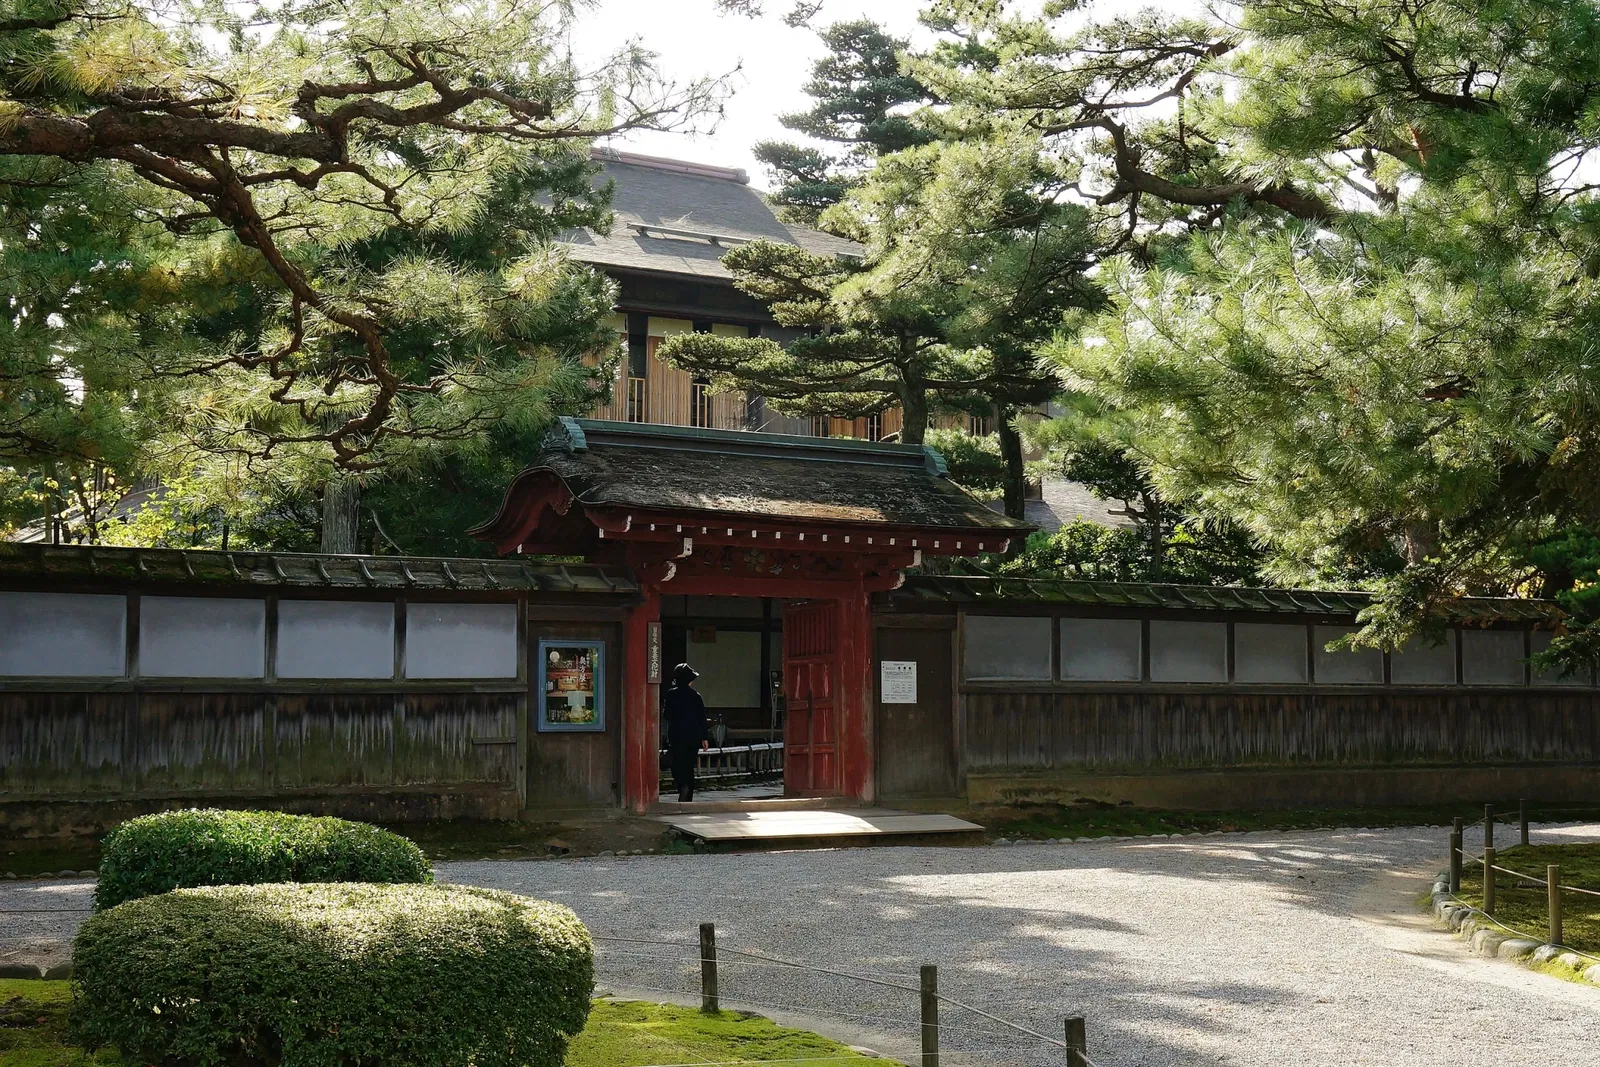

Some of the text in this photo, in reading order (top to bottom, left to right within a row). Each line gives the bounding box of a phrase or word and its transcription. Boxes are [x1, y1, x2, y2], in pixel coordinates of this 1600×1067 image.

[651, 645, 659, 679] 重要文化財
